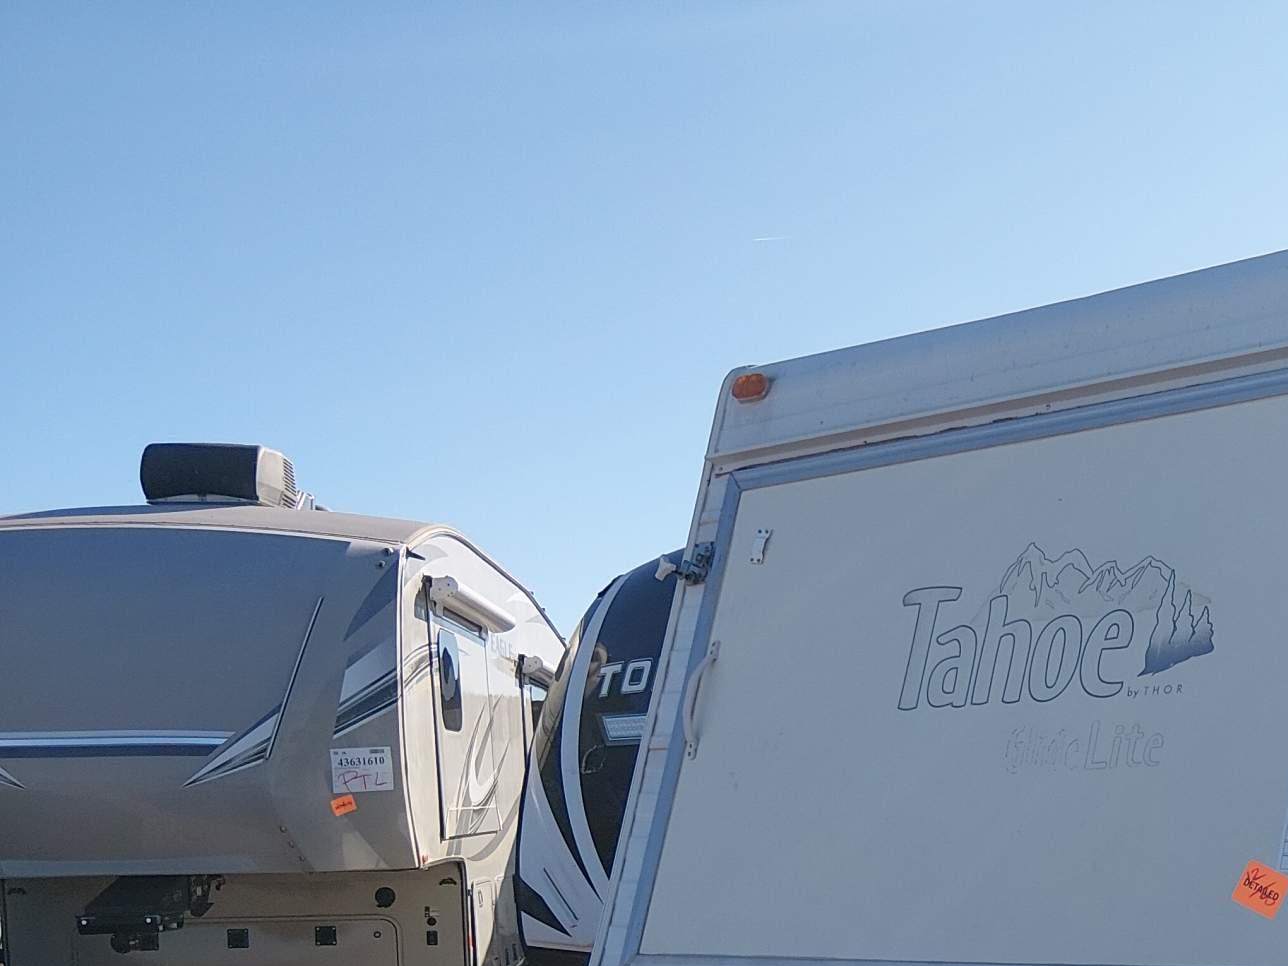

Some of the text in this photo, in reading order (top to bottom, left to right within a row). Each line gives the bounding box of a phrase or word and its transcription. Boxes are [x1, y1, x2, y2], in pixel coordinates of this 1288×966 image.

[898, 586, 1134, 711] Tahoe
[1127, 684, 1183, 699] by THOR
[337, 756, 385, 768] 43631610
